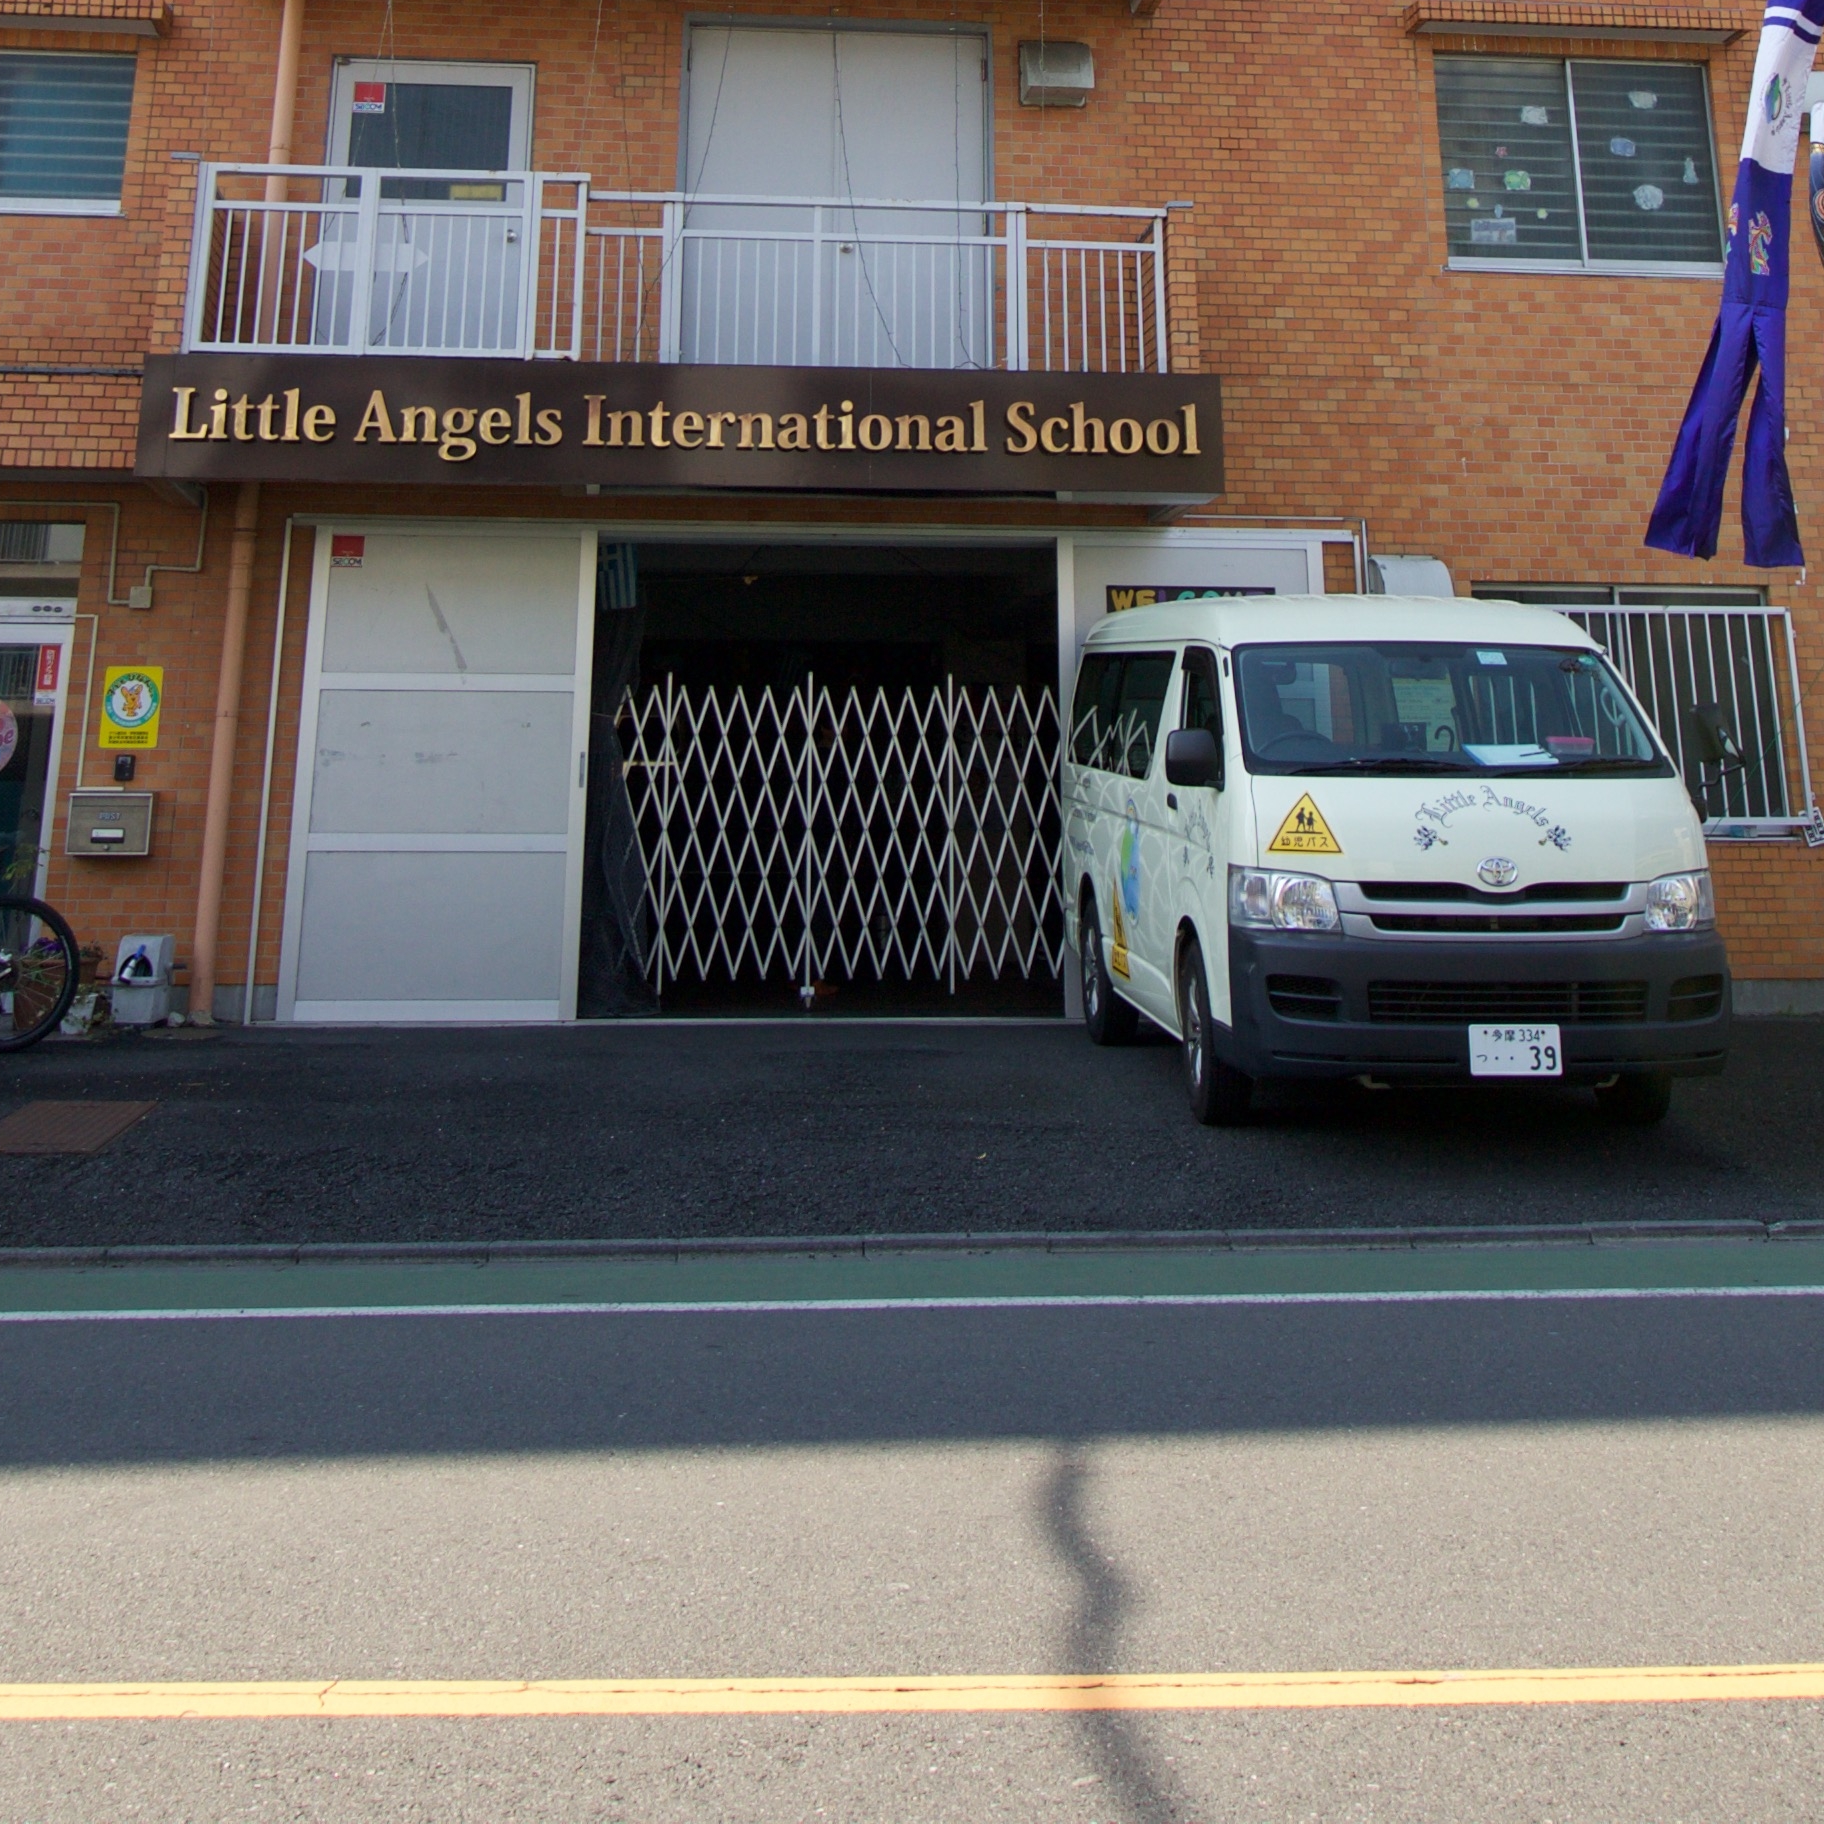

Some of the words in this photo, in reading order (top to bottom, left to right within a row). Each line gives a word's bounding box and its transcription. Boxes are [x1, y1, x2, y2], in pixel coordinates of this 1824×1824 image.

[168, 386, 336, 442] Little
[354, 389, 563, 462] Angels
[582, 393, 989, 452] International
[1004, 399, 1202, 456] School
[1414, 790, 1477, 828] Little
[1479, 784, 1550, 827] Angels
[1280, 836, 1329, 848] 幼児バス
[1492, 1029, 1516, 1042] 多摩
[1518, 1028, 1541, 1042] 334
[1529, 1045, 1557, 1071] 39
